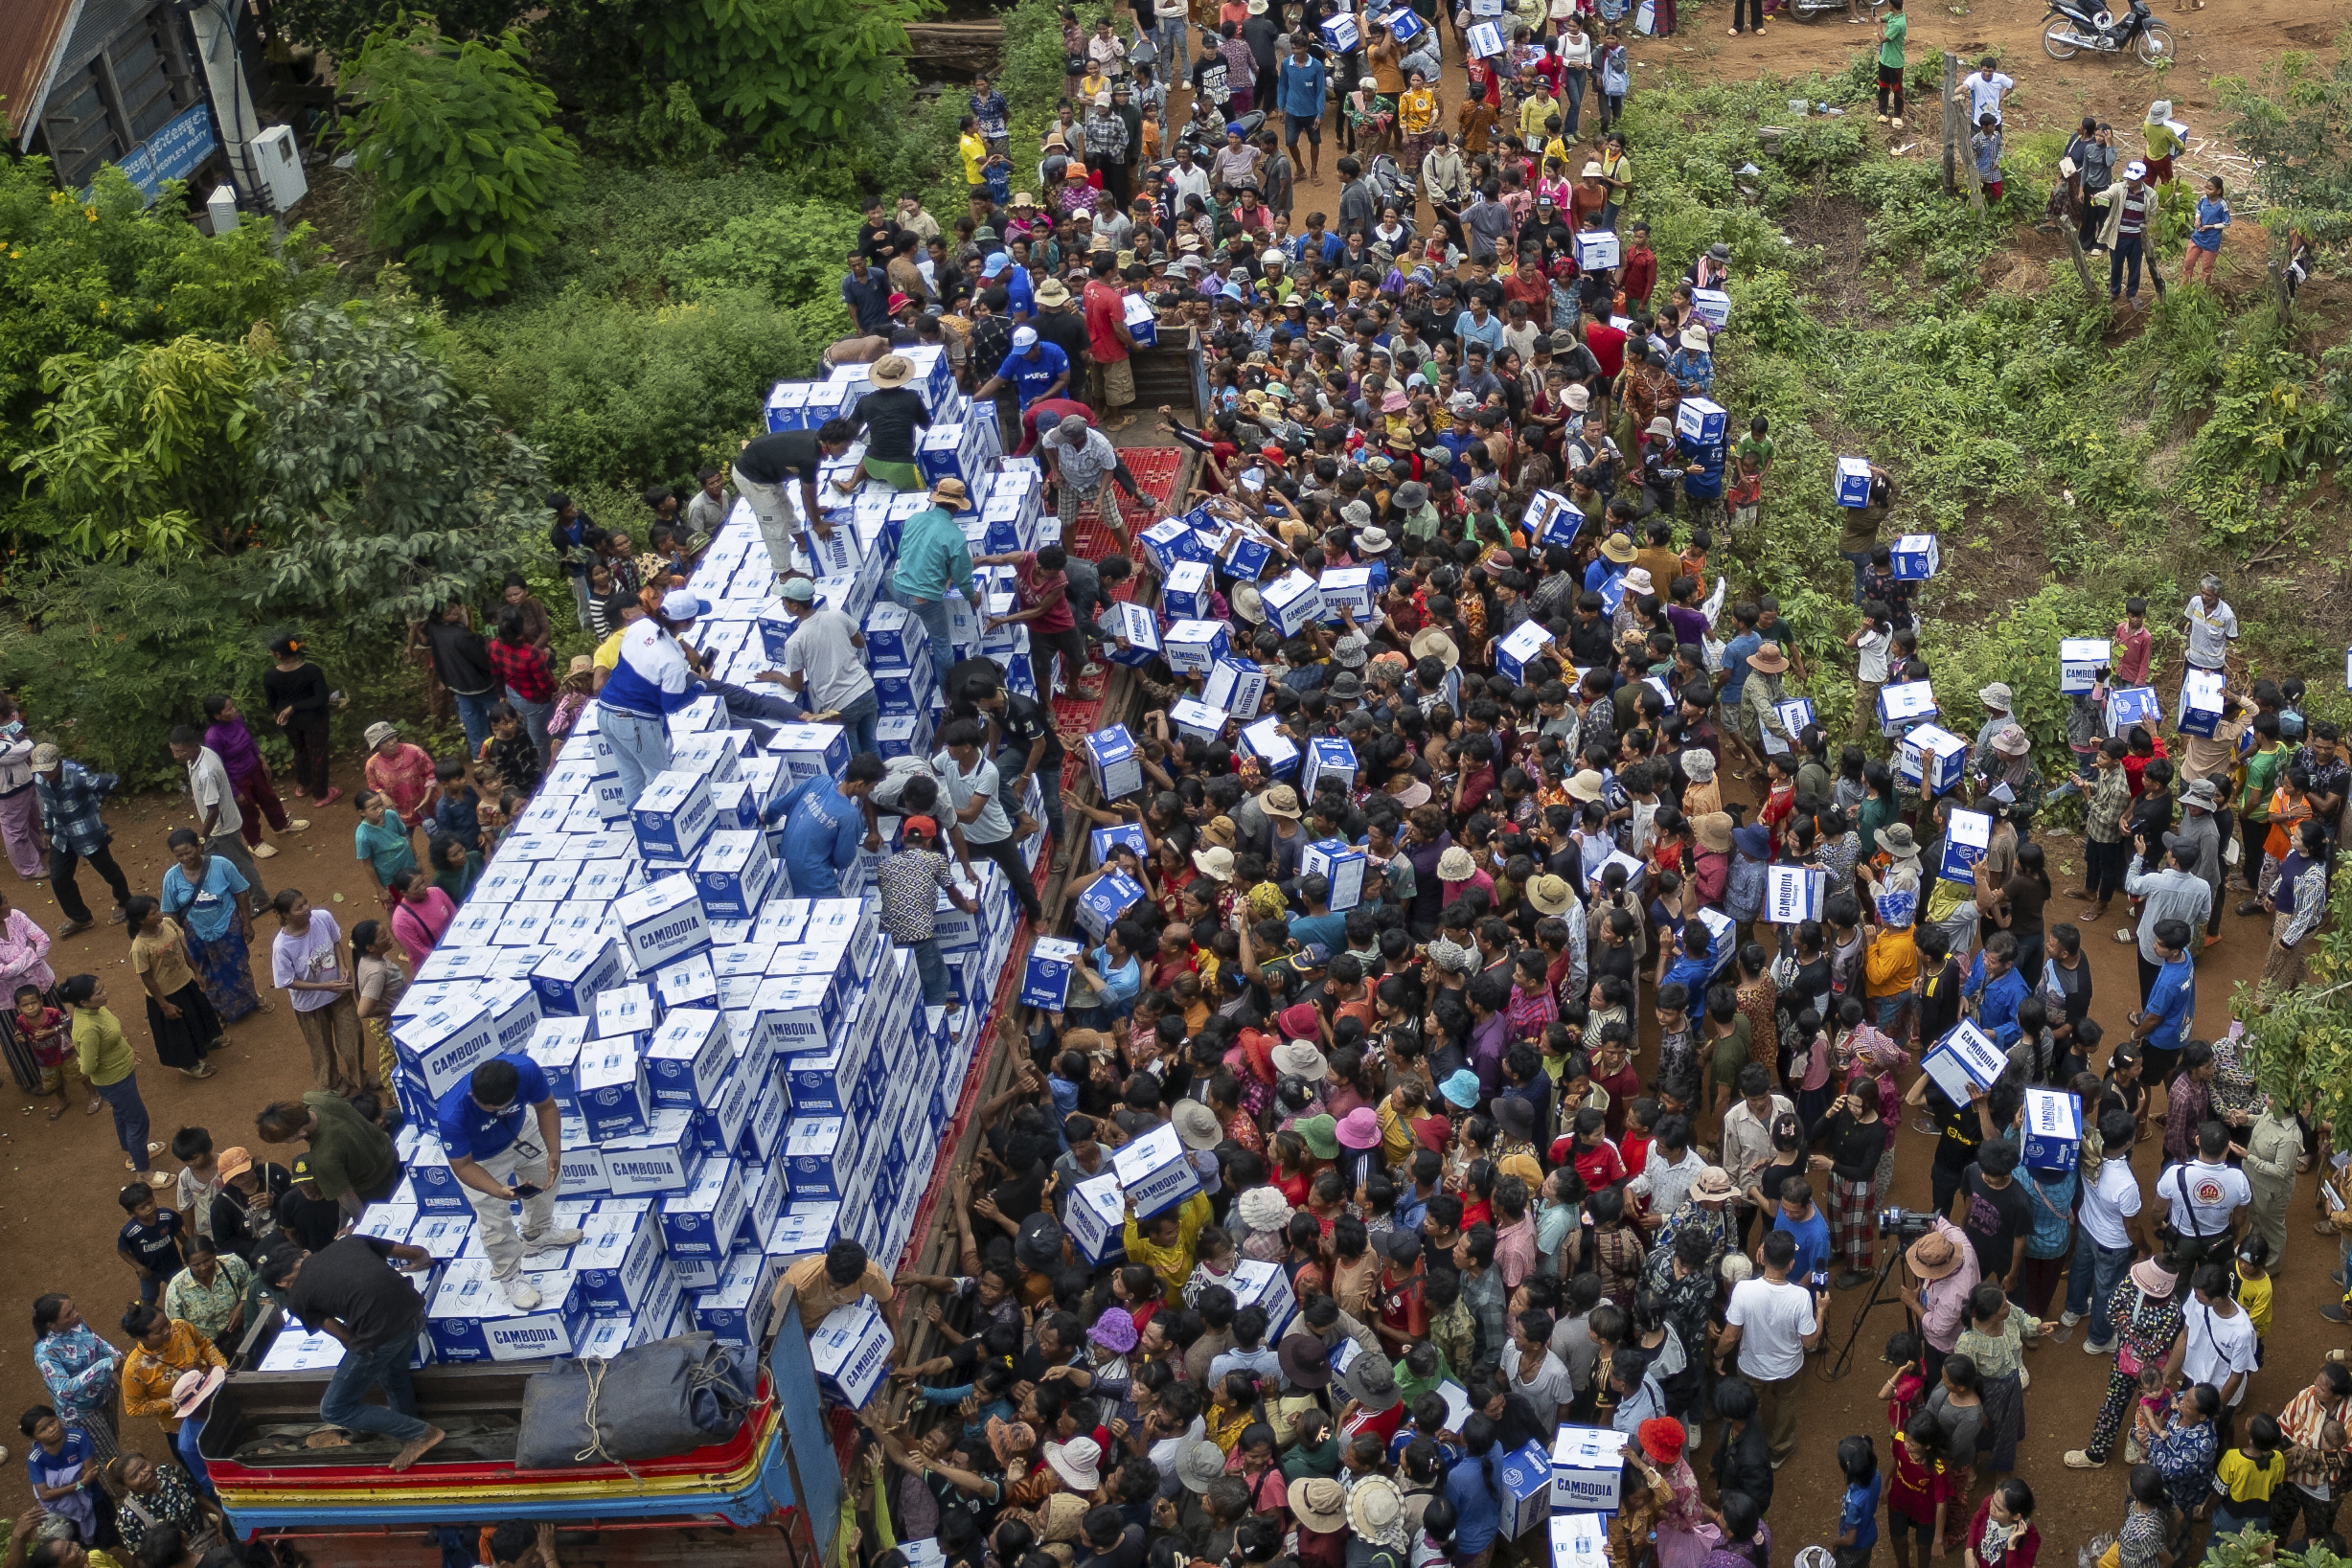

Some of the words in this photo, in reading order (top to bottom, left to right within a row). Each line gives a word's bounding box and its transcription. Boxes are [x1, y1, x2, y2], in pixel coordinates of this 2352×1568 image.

[156, 145, 187, 174] PEOPLE'S
[187, 128, 207, 148] PARTY
[1286, 597, 1319, 623] CAMBODIA
[1171, 649, 1206, 663] CAMBODIA
[1245, 677, 1261, 715] CAMBODIA
[680, 794, 711, 834] CAMBODIA
[1778, 874, 1793, 917] CAMBODIA
[640, 916, 699, 949] CAMBODIA
[934, 920, 970, 934] MBODIA
[582, 959, 620, 1003] CAMBODIA
[498, 1011, 537, 1046] MBODIA
[768, 1022, 817, 1035] AMBODIA
[432, 1032, 491, 1076] CAMBODIA
[699, 1033, 728, 1080] CAMBODIA
[1960, 1031, 1998, 1072] CAMBODIA
[2043, 1096, 2055, 1131] CAMBODIA
[562, 1164, 598, 1177] BODIA
[613, 1162, 674, 1176] CAMBODIA
[1135, 1170, 1187, 1201] CAMBODIA
[1071, 1201, 1099, 1244] CAMBODIA
[626, 1233, 651, 1286] CAMBODIA
[675, 1261, 705, 1274] ODIA
[651, 1269, 674, 1322] CAMBODIA
[493, 1329, 559, 1344] CAMBODIA
[846, 1333, 886, 1388] CAMBODIA
[1558, 1478, 1611, 1496] CAMBODIA
